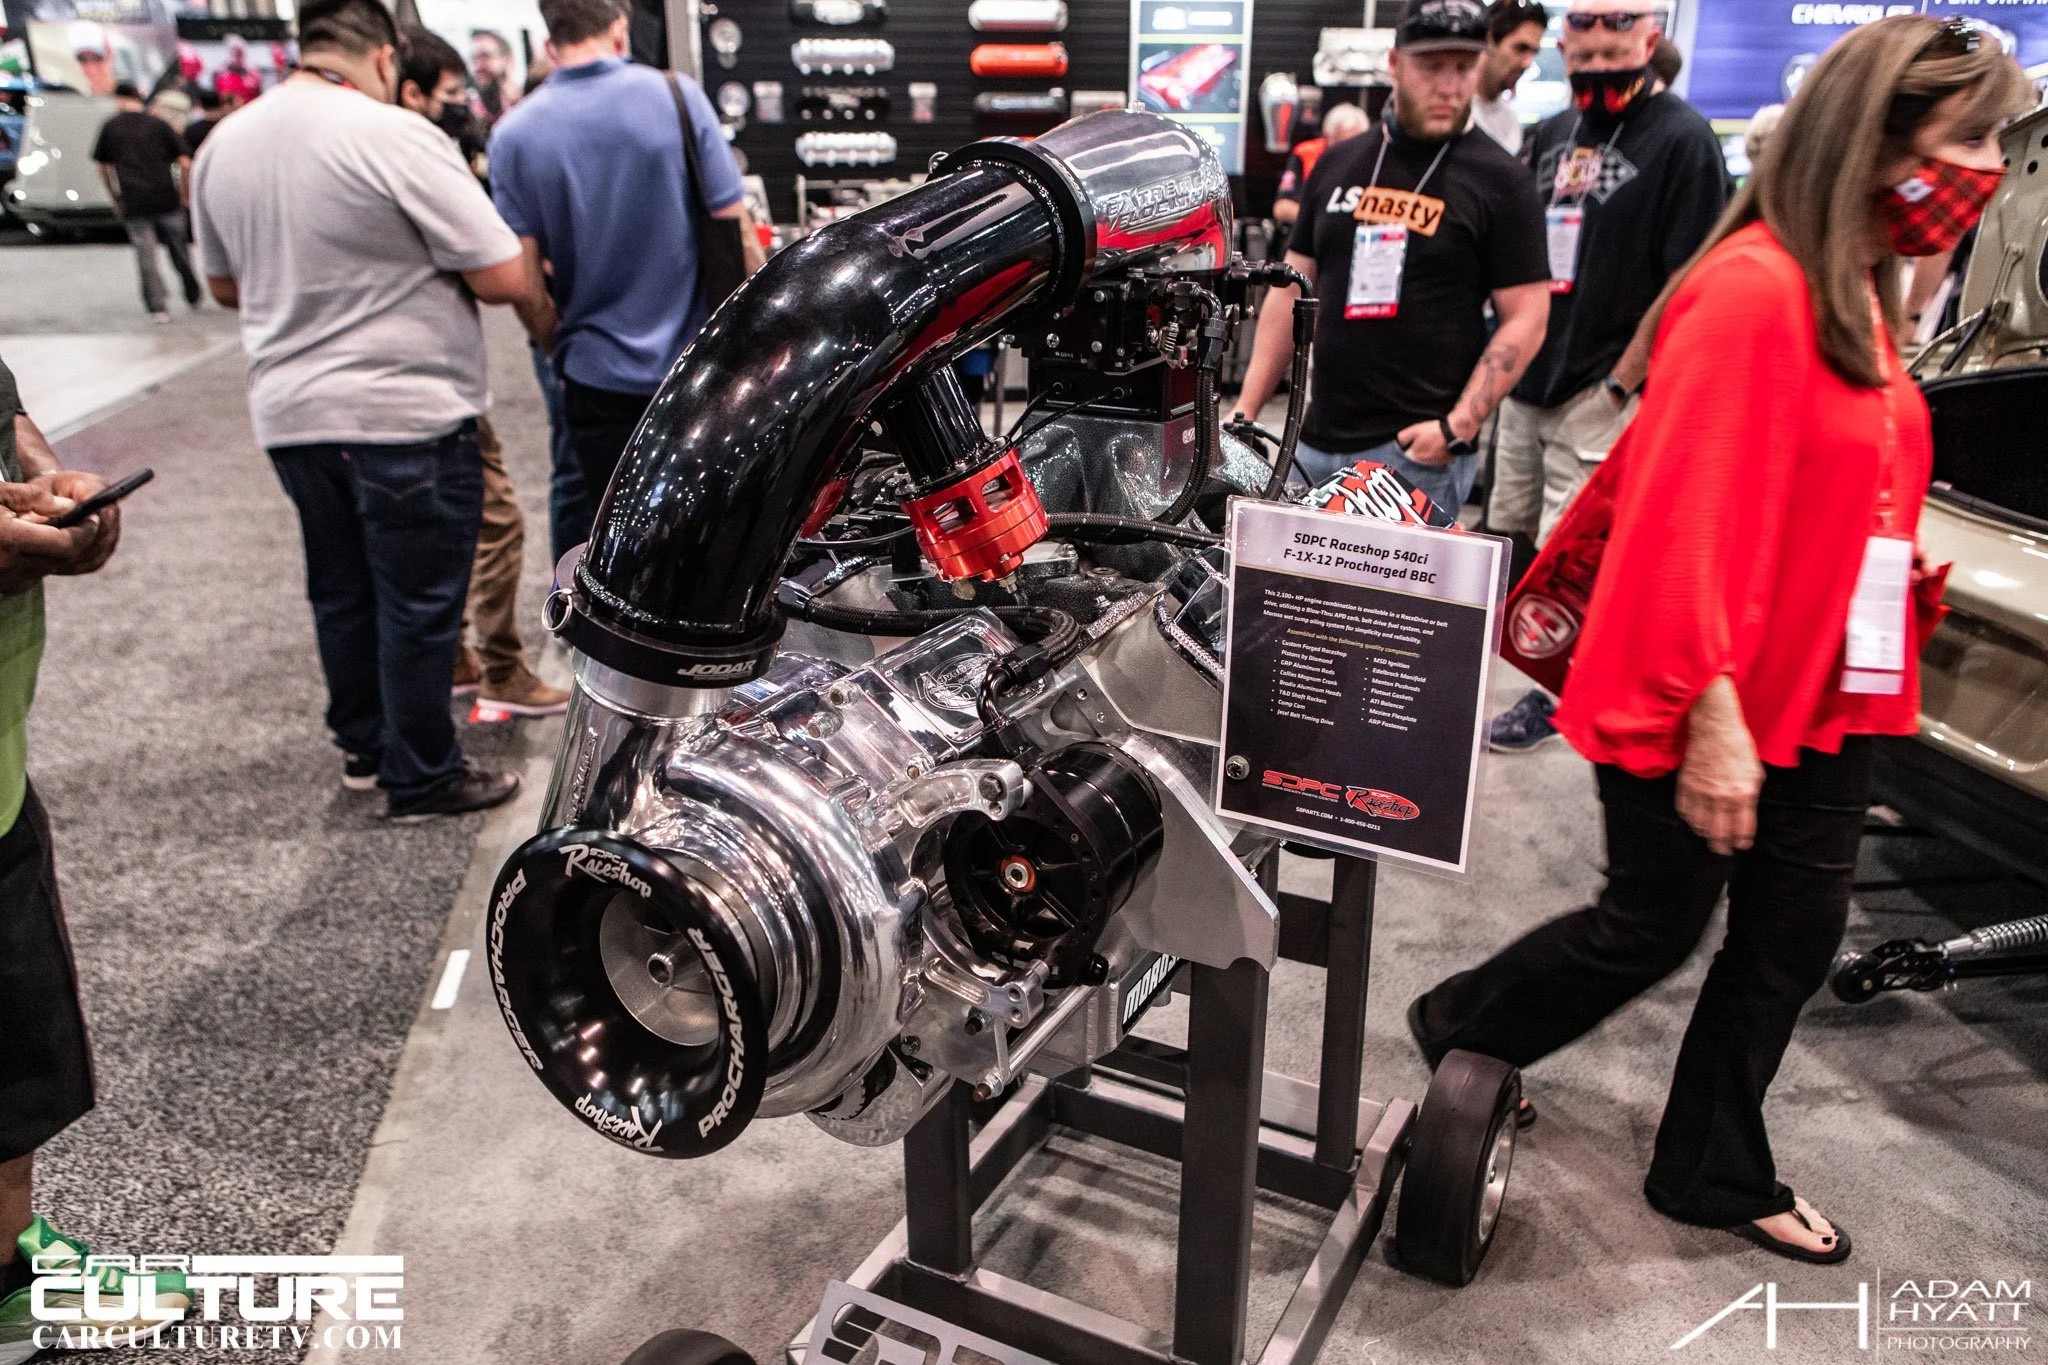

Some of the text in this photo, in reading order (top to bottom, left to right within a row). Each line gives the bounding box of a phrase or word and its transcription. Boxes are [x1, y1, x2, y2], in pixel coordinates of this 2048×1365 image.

[1326, 186, 1439, 228] LS nasty
[1294, 533, 1429, 565] SDPC Raceshop 540ci
[1284, 548, 1437, 584] F-1X-12 Procharged BBC
[1263, 599, 1278, 608] drive,
[1278, 603, 1301, 613] utilizing
[1306, 607, 1334, 618] Blow-Thru
[1361, 617, 1373, 625] belt
[1373, 619, 1387, 627] drive
[1387, 621, 1400, 629] fuel
[1400, 625, 1422, 634] system,
[1264, 588, 1276, 597] This
[1303, 597, 1322, 605] engine
[1322, 600, 1357, 611] combination
[1363, 607, 1389, 617] available
[1400, 613, 1429, 624] RaceDrive
[1436, 620, 1449, 628] belt
[1263, 609, 1284, 618] Moroso
[1294, 616, 1310, 624] sump
[1309, 619, 1326, 627] oiling
[1325, 622, 1346, 630] system
[1345, 624, 1355, 632] for
[1354, 626, 1382, 638] simplicity
[1393, 634, 1422, 645] reliability.
[1281, 639, 1348, 658] Custom Forged Raceshop
[1286, 628, 1316, 639] Assembled
[1315, 633, 1329, 641] with
[1338, 638, 1364, 649] following
[1364, 643, 1385, 653] quality
[1281, 649, 1334, 665] Pistons by Diamond
[1373, 657, 1410, 670] MSD Ignition
[677, 660, 757, 676] JODAR
[1292, 662, 1321, 673] Aluminum
[1321, 667, 1336, 676] Rods
[1372, 667, 1427, 683] Edelbrock Manifold
[1279, 669, 1338, 686] Callies Magnum Crank
[1279, 679, 1342, 697] Brodix Aluminum Heads
[1370, 688, 1414, 702] Flatout Gaskets
[1394, 682, 1421, 693] Pushrods
[1279, 689, 1327, 705] T&D Shaft Rockers
[1380, 700, 1405, 710] Balancer
[1289, 711, 1301, 719] Belt
[1301, 713, 1321, 724] Timing
[1320, 718, 1335, 726] Drive
[1381, 720, 1408, 732] Fasteners
[1391, 712, 1418, 723] Flexplate
[1262, 769, 1341, 800] SDPC
[1346, 785, 1415, 818] Raceshop
[1295, 806, 1334, 820] SDPARTS.COM
[590, 847, 621, 864] SDPC
[558, 843, 652, 898] Raceshop
[490, 868, 544, 1070] PROCHARGER
[687, 927, 744, 1138] PROCHARGER
[574, 1092, 665, 1152] Raceshop
